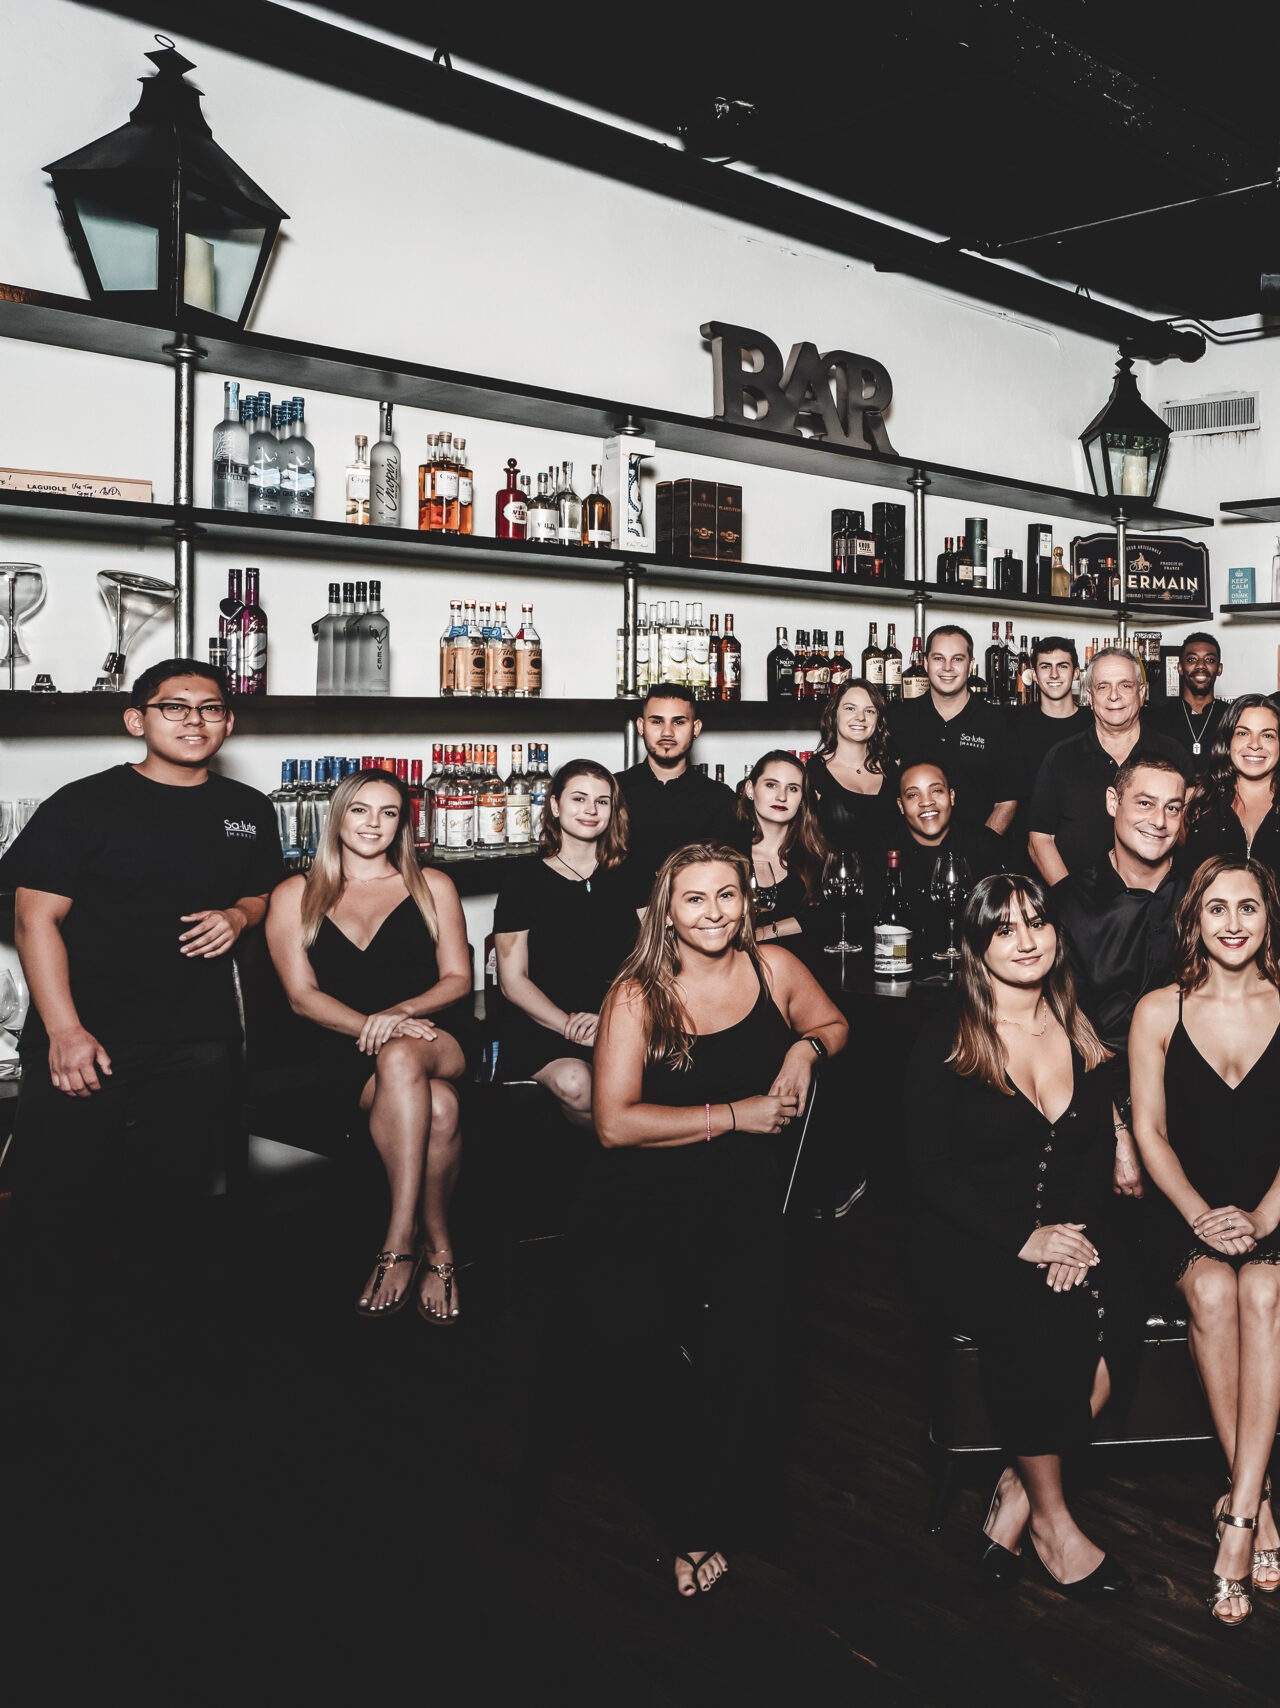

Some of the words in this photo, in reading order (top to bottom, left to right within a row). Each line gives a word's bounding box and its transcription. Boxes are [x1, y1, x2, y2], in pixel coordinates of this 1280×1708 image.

[700, 320, 899, 456] BAR
[27, 483, 67, 492] LAGUIOLE
[1127, 574, 1199, 591] ERMAIN
